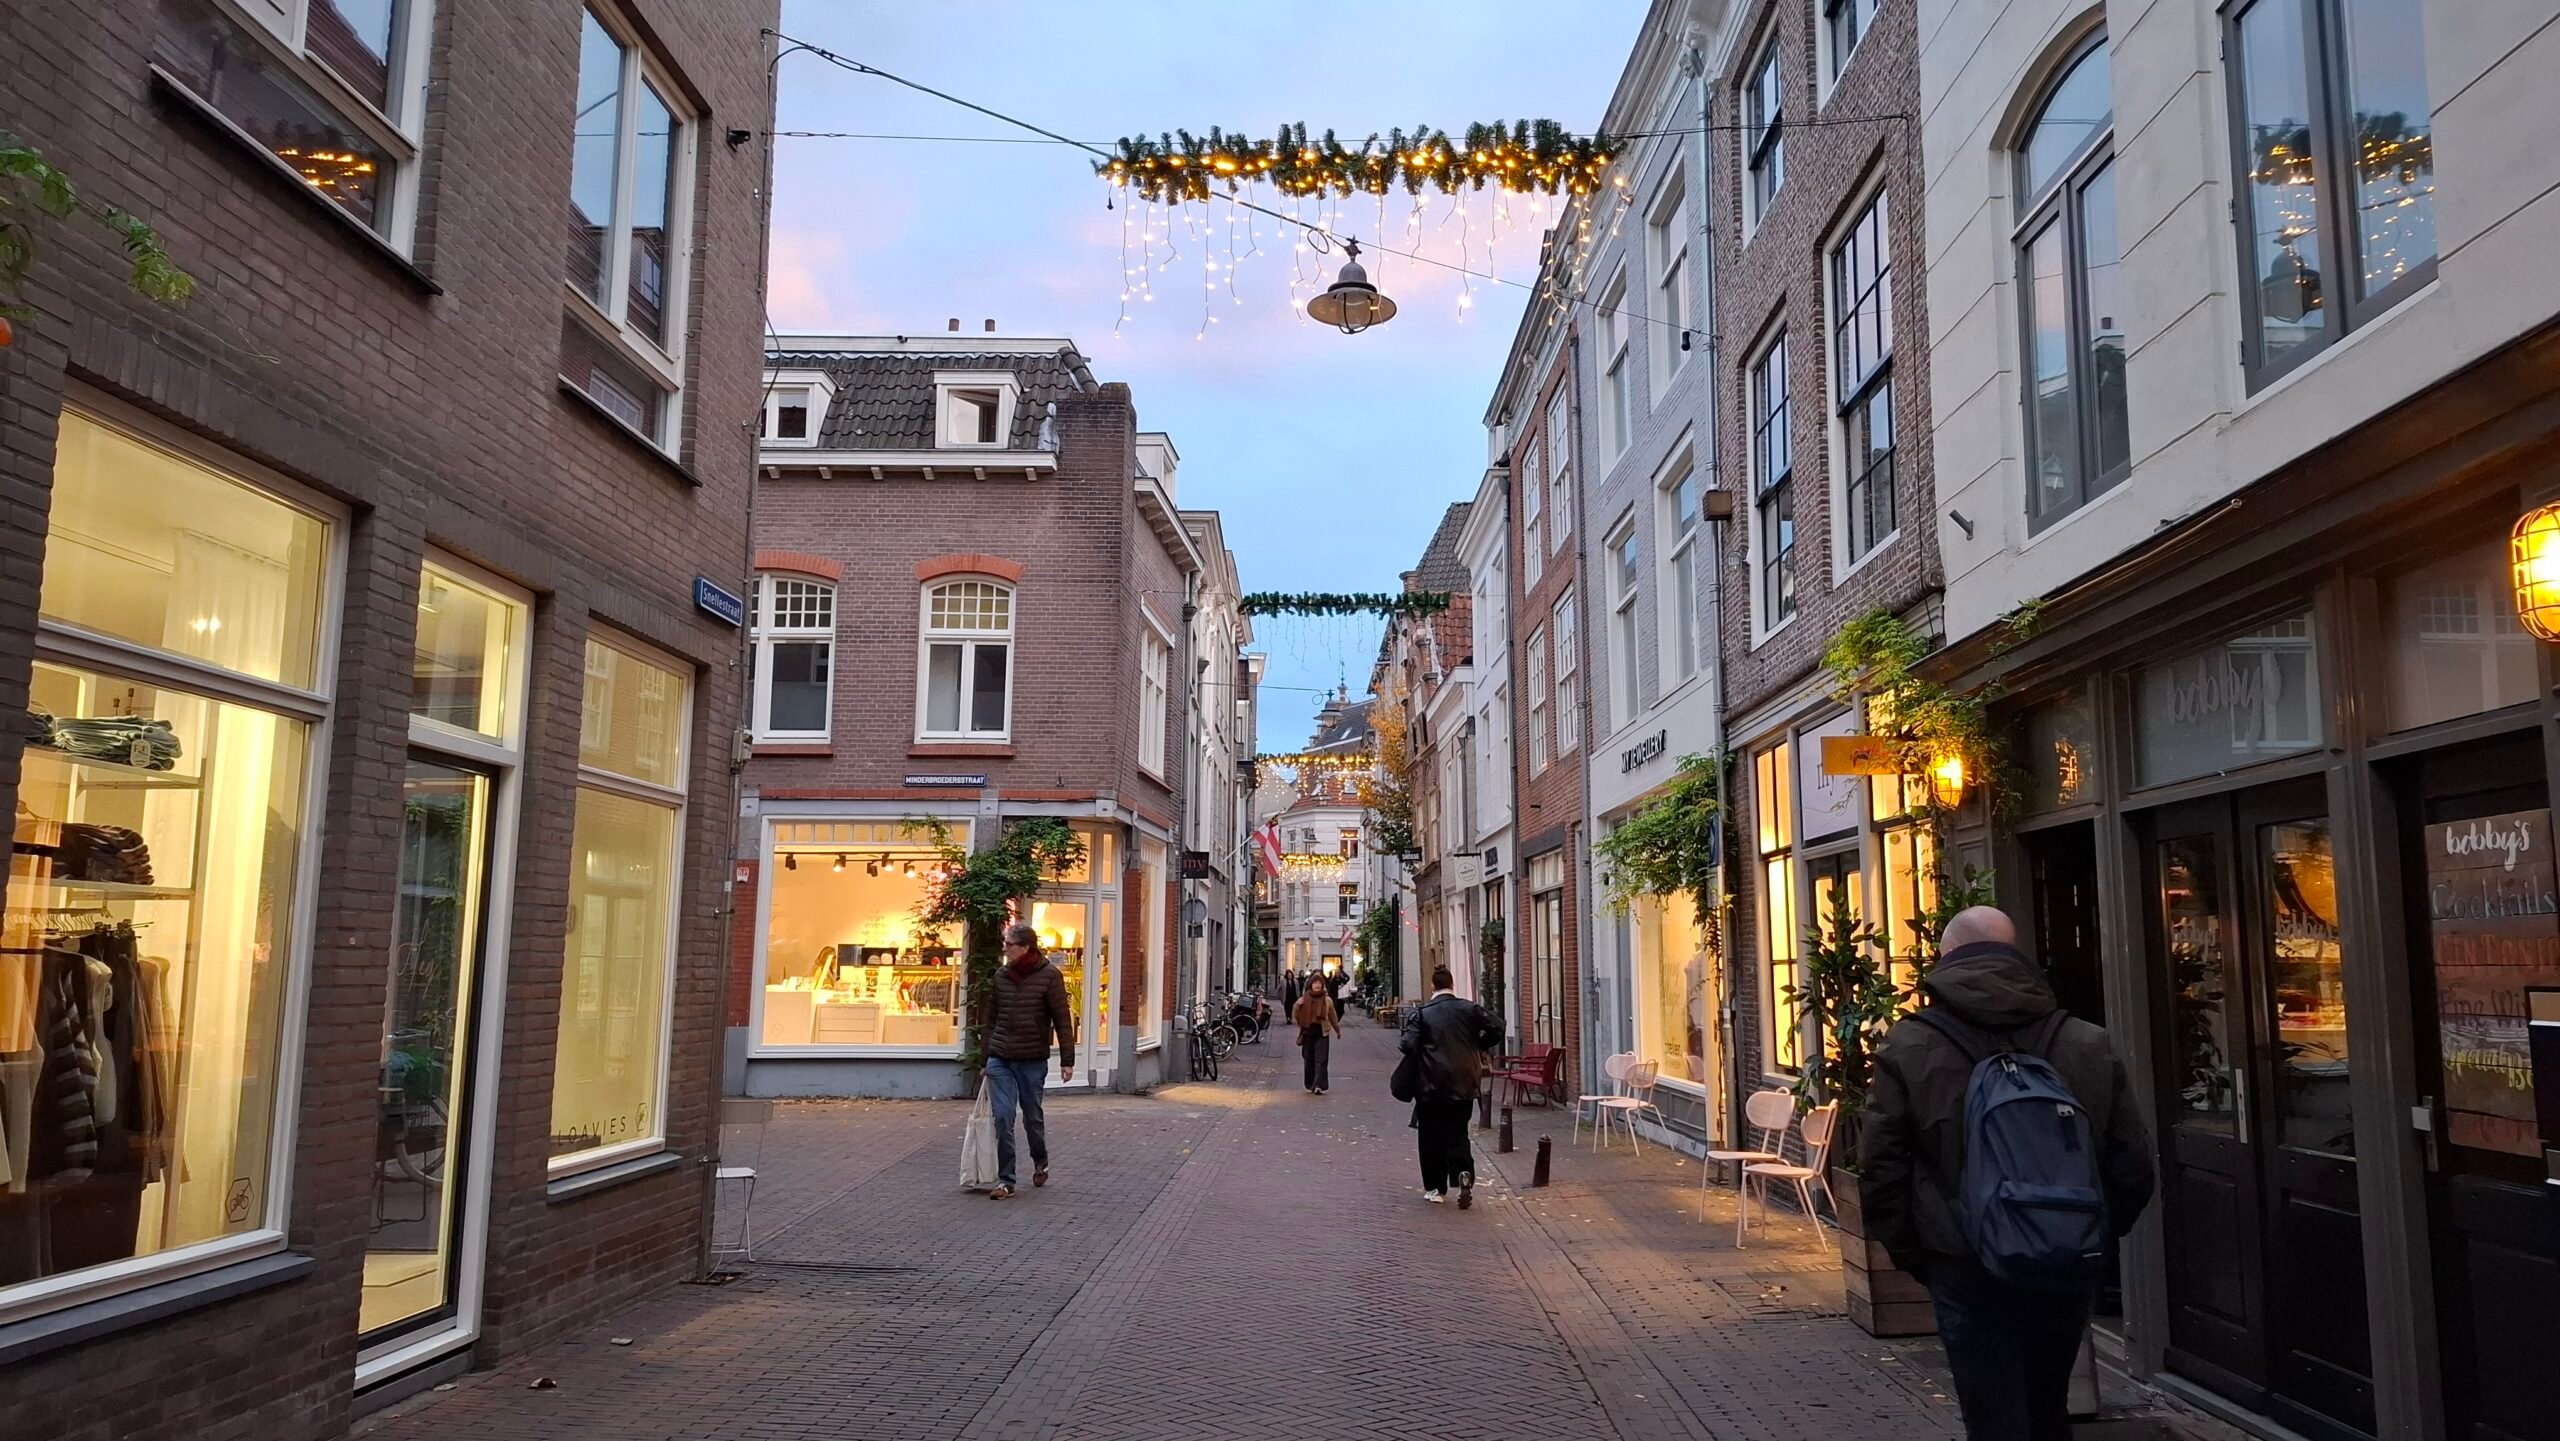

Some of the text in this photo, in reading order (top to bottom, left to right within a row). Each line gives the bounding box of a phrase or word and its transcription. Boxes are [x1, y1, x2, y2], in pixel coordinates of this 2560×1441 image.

[702, 587, 741, 619] Snellestraat
[1621, 729, 1667, 774] MY JEWELLERY
[905, 776, 985, 785] MINDERBROEDERSSTRAAT
[2445, 818, 2531, 873] bobby's
[1183, 858, 1207, 872] my
[2431, 873, 2557, 921] Cocktails
[2438, 989, 2489, 1029] Fine
[558, 1116, 627, 1147] LOAVIES
